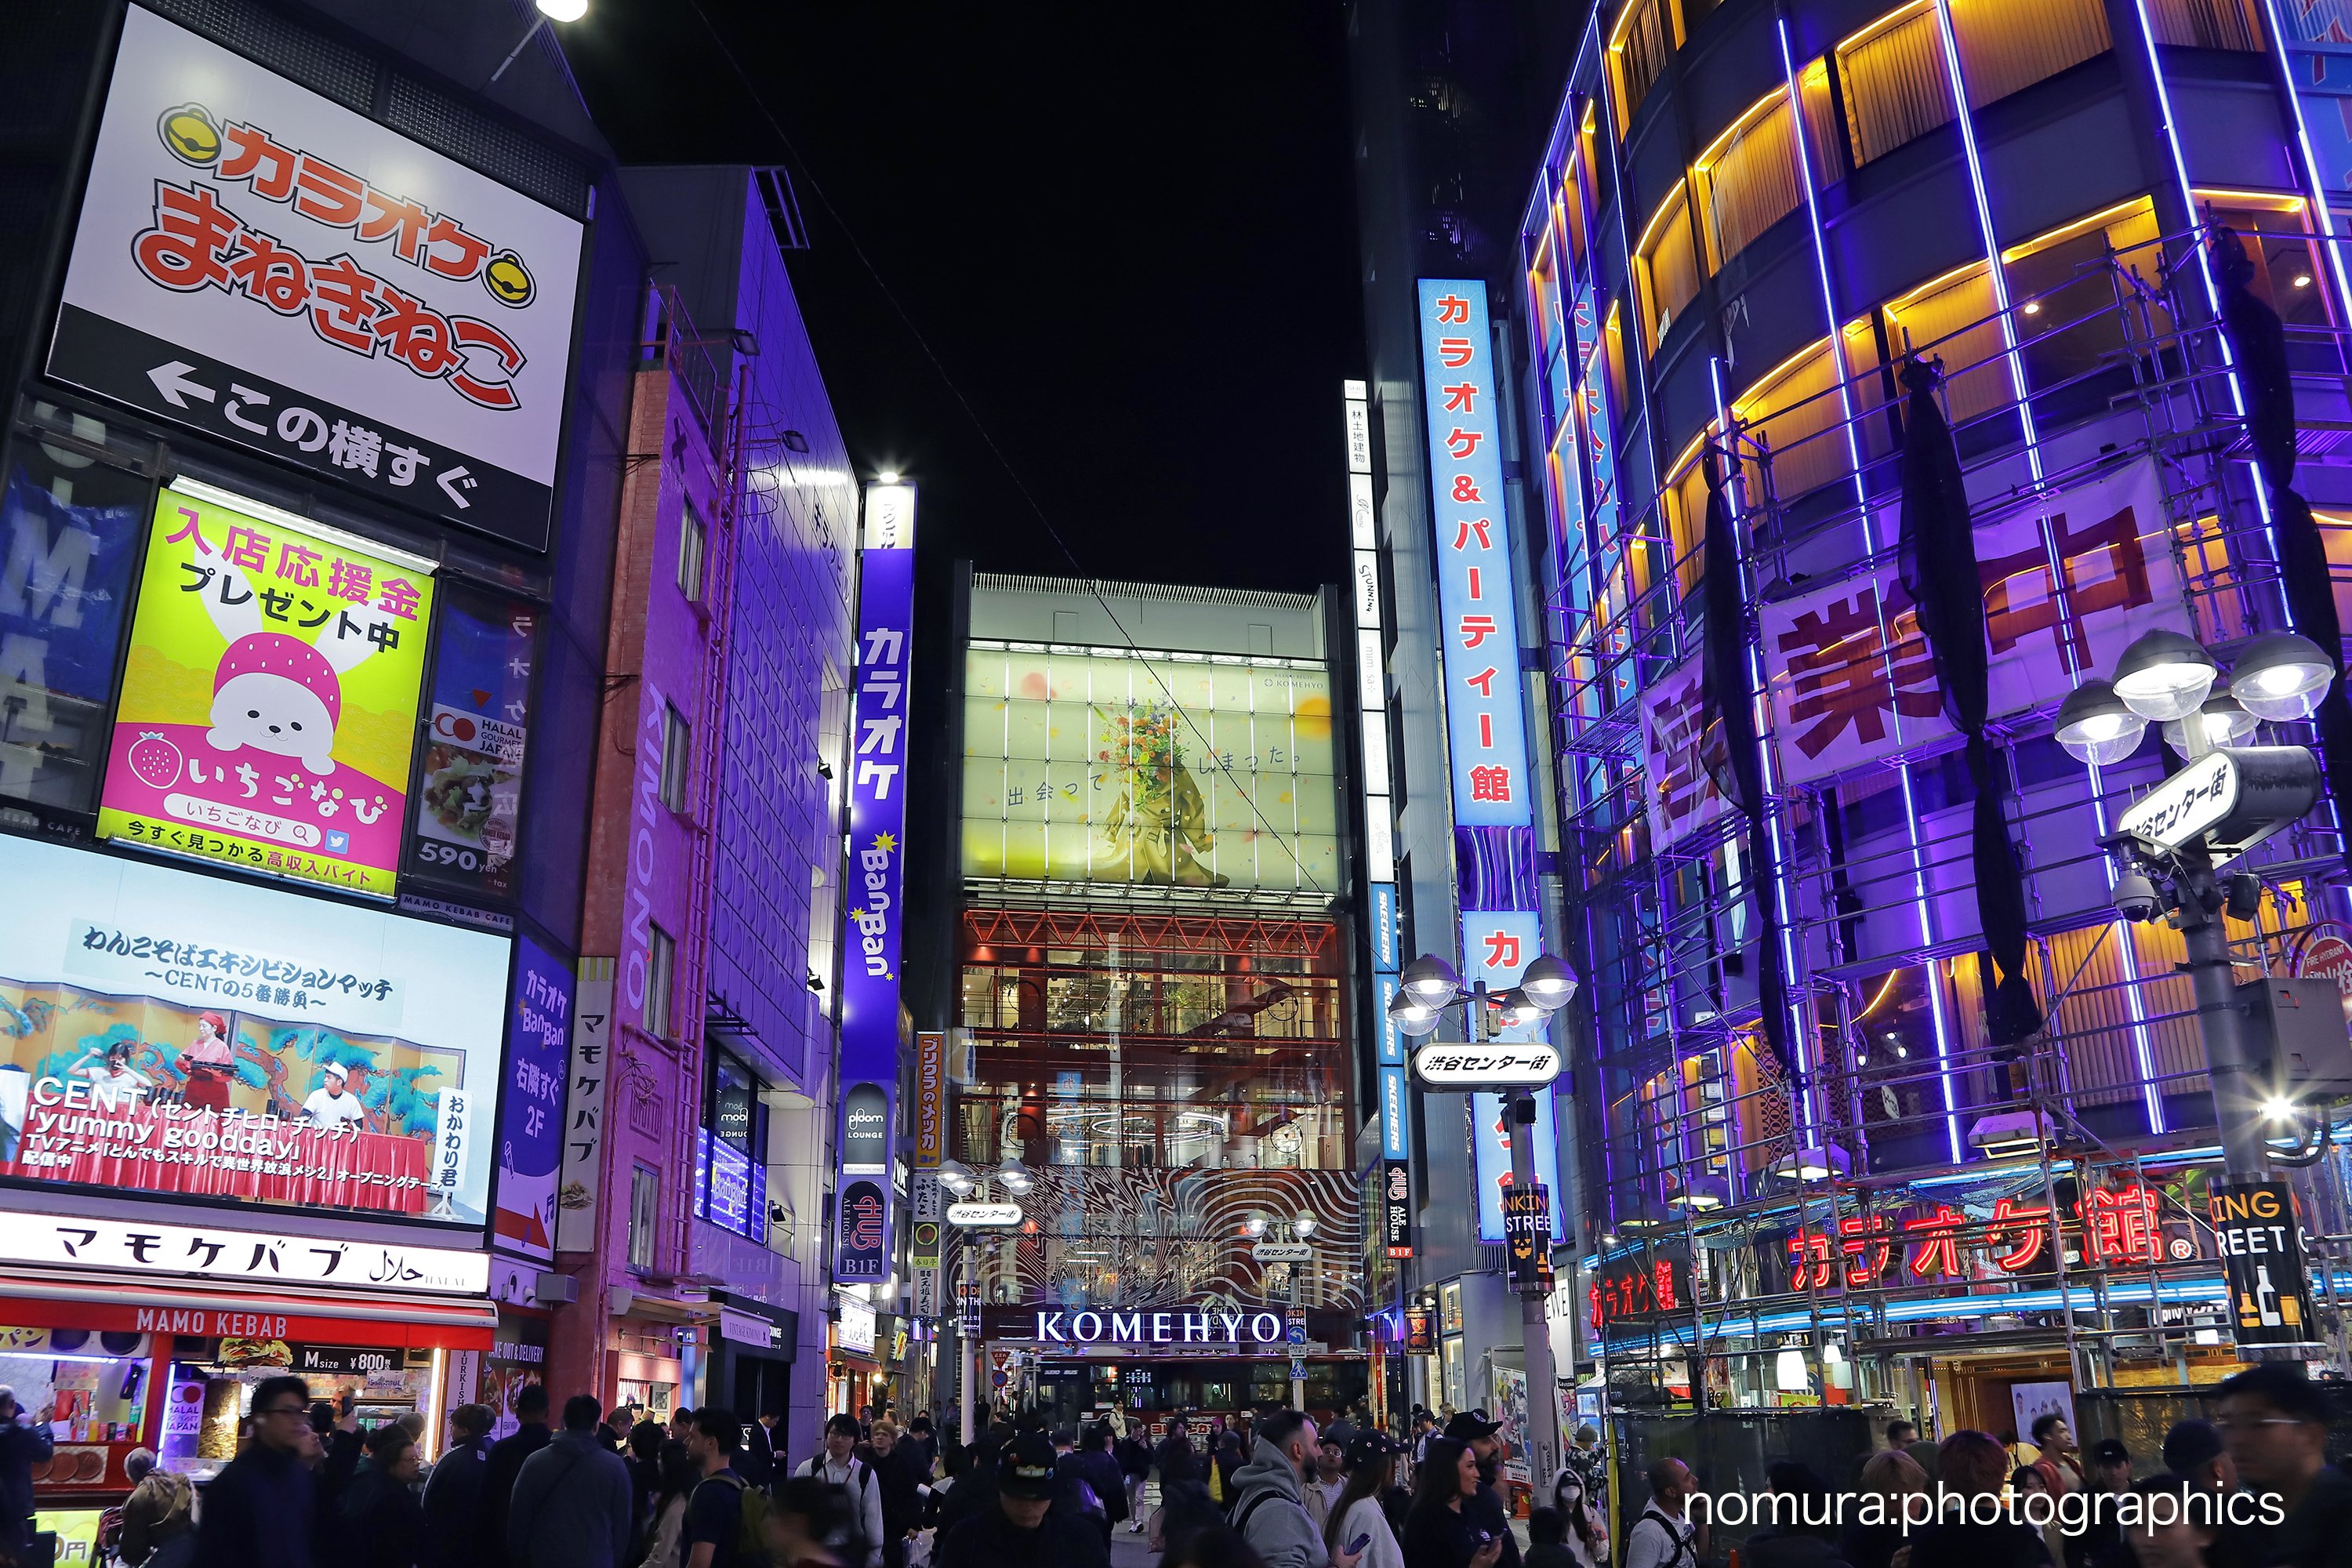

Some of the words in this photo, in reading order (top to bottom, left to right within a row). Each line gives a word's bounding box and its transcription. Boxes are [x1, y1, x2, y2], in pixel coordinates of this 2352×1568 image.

[216, 120, 493, 282] カラオケ
[132, 179, 527, 411] まねきねこ
[223, 383, 478, 510] この横すぐ
[1352, 410, 1366, 464] 林土地建物
[165, 506, 423, 622] 入店応援金
[1436, 294, 1512, 803] カラオケ&パーティー館
[180, 562, 400, 653] プレゼント中
[1276, 681, 1323, 689] KOMEHYO
[481, 720, 522, 739] HALAL
[856, 627, 905, 800] カラオケ
[481, 732, 521, 746] GOURMET
[189, 757, 387, 826] いちごなび
[1008, 774, 1103, 807] 出会って
[186, 799, 284, 836] いちごなび
[127, 818, 372, 886] 今すぐ見つかる高収入バイト
[418, 842, 477, 870] 590
[628, 682, 665, 1010] KIMONO
[404, 896, 440, 910] MAMO
[445, 905, 480, 919] KEBAB
[485, 913, 510, 926] CAFE
[859, 848, 891, 978] BanBan
[1378, 890, 1392, 965] SKECHERS
[82, 926, 394, 1002] わんこそばエキシビションマッチ
[2307, 955, 2319, 967] FIRE
[2319, 945, 2345, 962] HYDRANT
[526, 968, 568, 1020] カラオケ
[522, 1007, 564, 1047] BanBan
[516, 1057, 559, 1107] 右隣すぐ
[1425, 1055, 1552, 1071] 渋谷センター街
[570, 1014, 605, 1163] マモケバブ
[922, 1037, 938, 1151] プリクラのメッカ
[524, 1104, 545, 1138] 2F
[848, 1108, 884, 1131] ploom
[1387, 1073, 1401, 1153] SKECHERS
[22, 1150, 72, 1169] 配信中
[441, 1095, 464, 1189] おかわり君
[919, 1154, 936, 1163] 3F
[1388, 1167, 1407, 1200] HUB
[852, 1196, 882, 1250] HUB
[951, 1210, 1018, 1218] 渋谷センター街
[1390, 1206, 1399, 1241] HOUSE
[2211, 1191, 2280, 1222] ING
[56, 1226, 349, 1276] マモケバブ
[1788, 1185, 2166, 1291] カラオケ館
[368, 1248, 424, 1283] حلال
[425, 1276, 468, 1287] HALAL
[844, 1258, 879, 1274] B1F
[136, 1308, 205, 1334] MAMO
[216, 1312, 287, 1338] KEBAB
[1036, 1312, 1282, 1343] KOMEHYO
[350, 1354, 384, 1370] ¥800
[503, 1342, 514, 1359] OUT
[519, 1345, 544, 1363] DELIVERY
